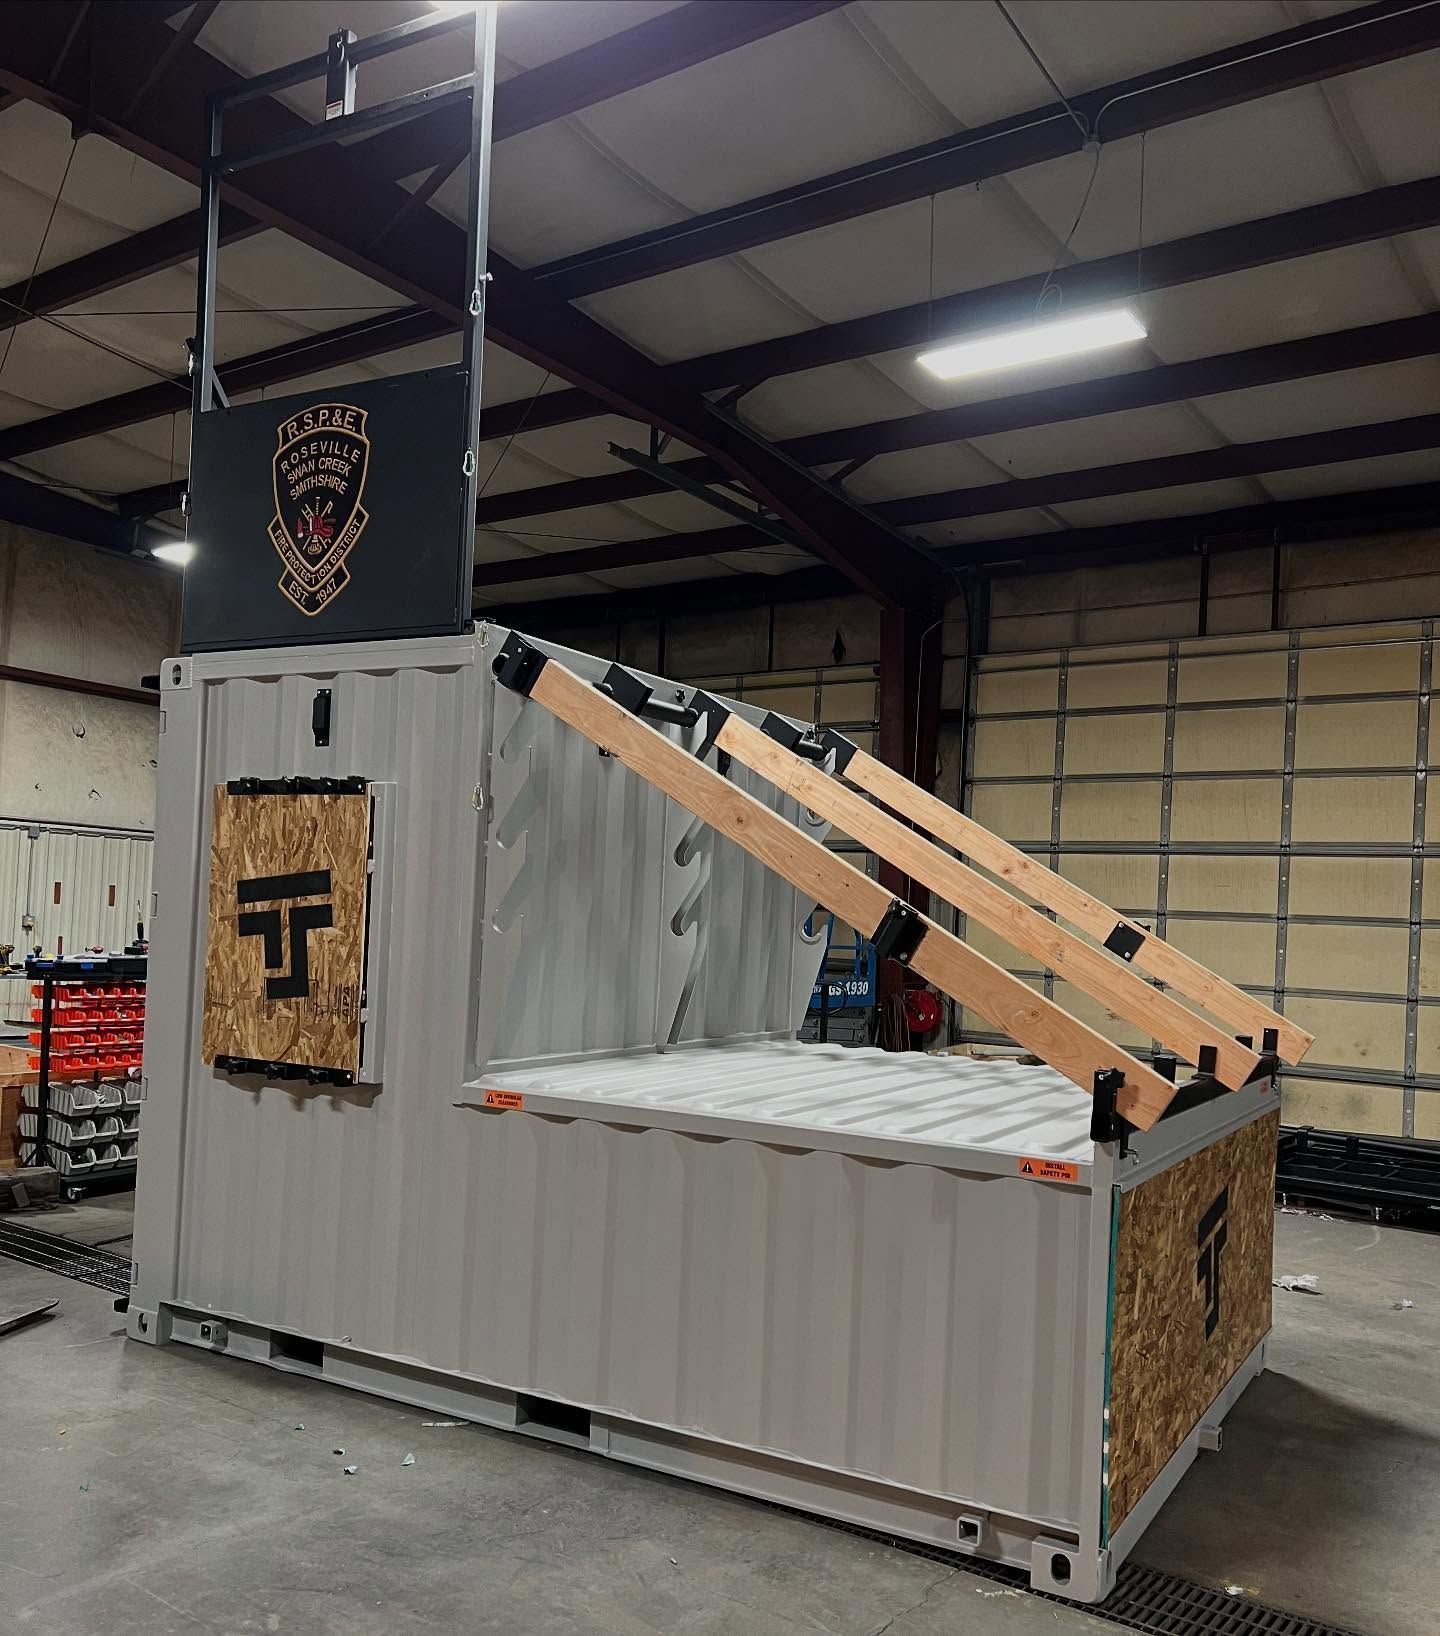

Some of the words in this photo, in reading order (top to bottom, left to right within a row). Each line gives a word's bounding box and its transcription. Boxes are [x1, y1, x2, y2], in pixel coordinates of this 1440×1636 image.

[280, 440, 361, 474] ROSEVILLE
[287, 459, 316, 484] SWAN
[318, 457, 353, 477] CREEK
[290, 474, 349, 501] SMITHSHIRE
[274, 529, 289, 554] FIRE
[285, 551, 332, 585] PROTECTION
[330, 518, 361, 565] DISTRICT
[289, 581, 309, 606] EST.
[315, 578, 338, 605] 1947
[1039, 1169, 1060, 1178] SAFETY
[1045, 1162, 1066, 1170] INSTALL
